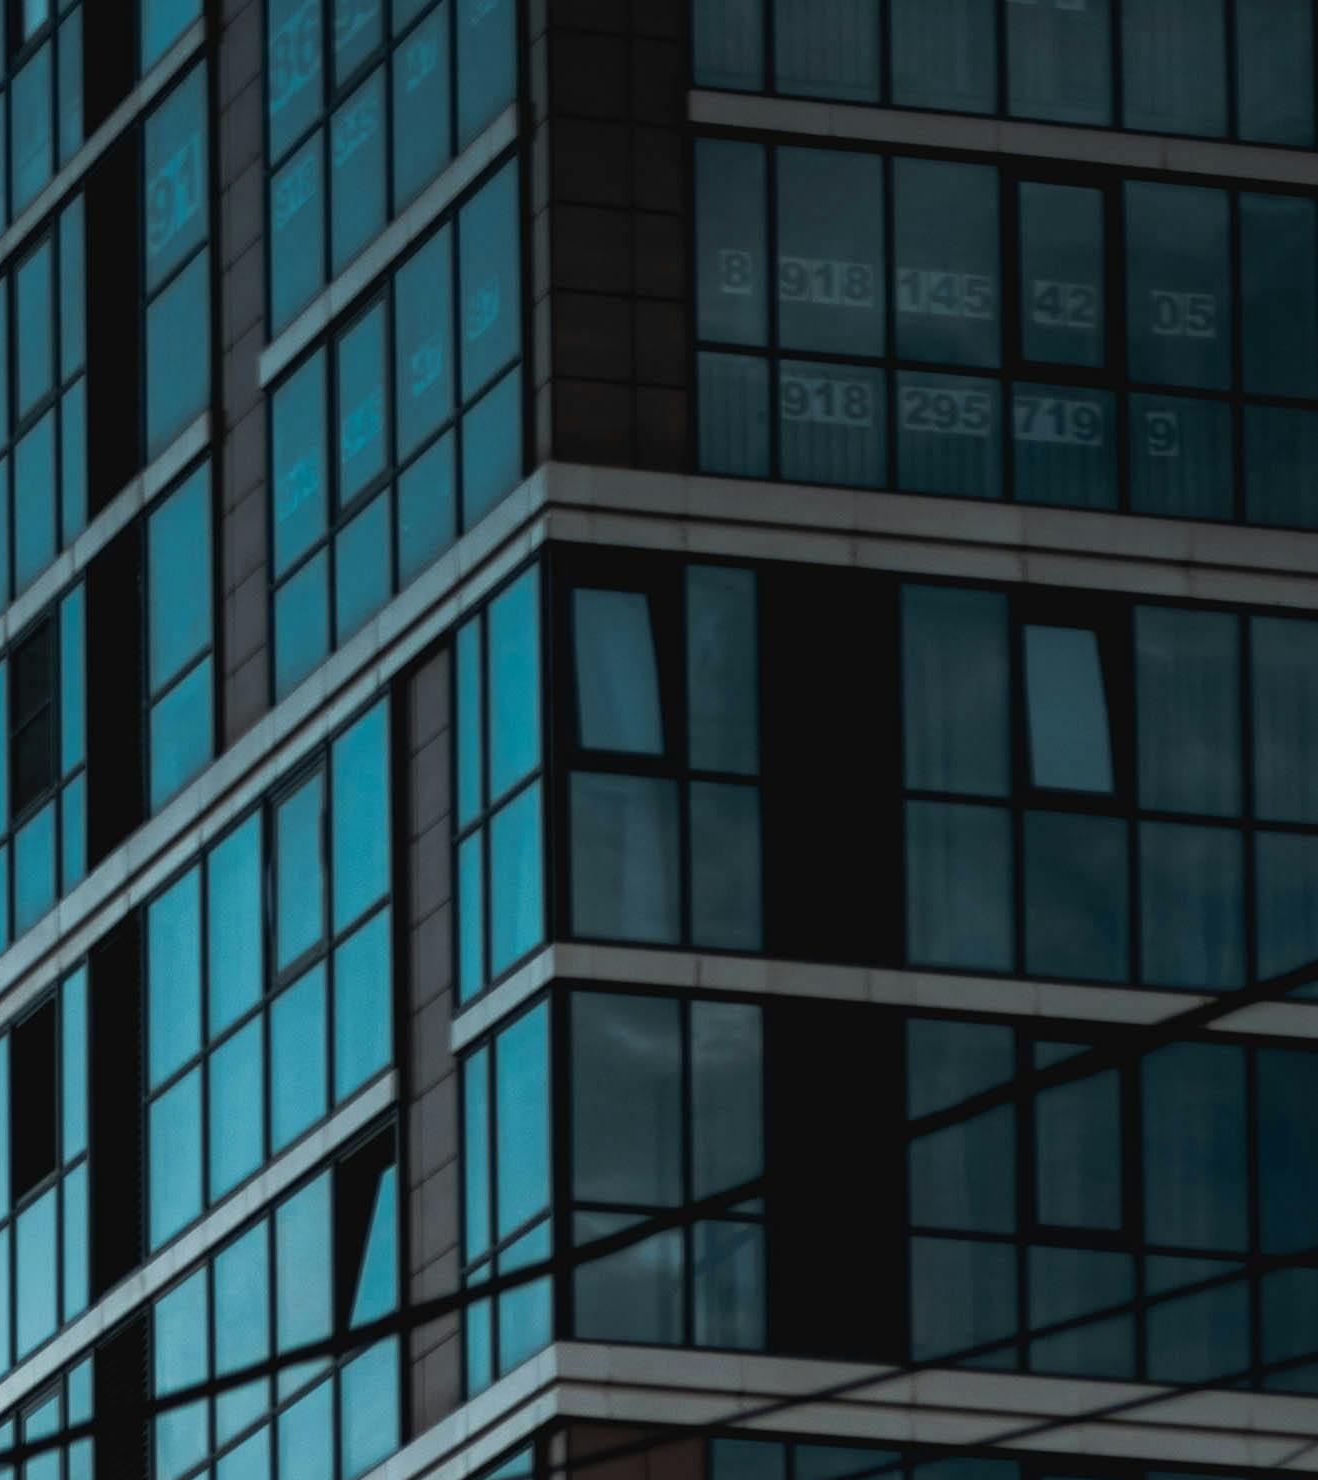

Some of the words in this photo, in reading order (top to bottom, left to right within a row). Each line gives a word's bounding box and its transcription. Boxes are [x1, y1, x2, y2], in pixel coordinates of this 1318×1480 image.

[725, 252, 750, 290] 8
[780, 258, 873, 301] 918
[902, 270, 994, 317] 145
[1035, 284, 1096, 325] 42
[1152, 295, 1216, 333] 05
[782, 382, 871, 421] 918
[904, 389, 990, 432] 295
